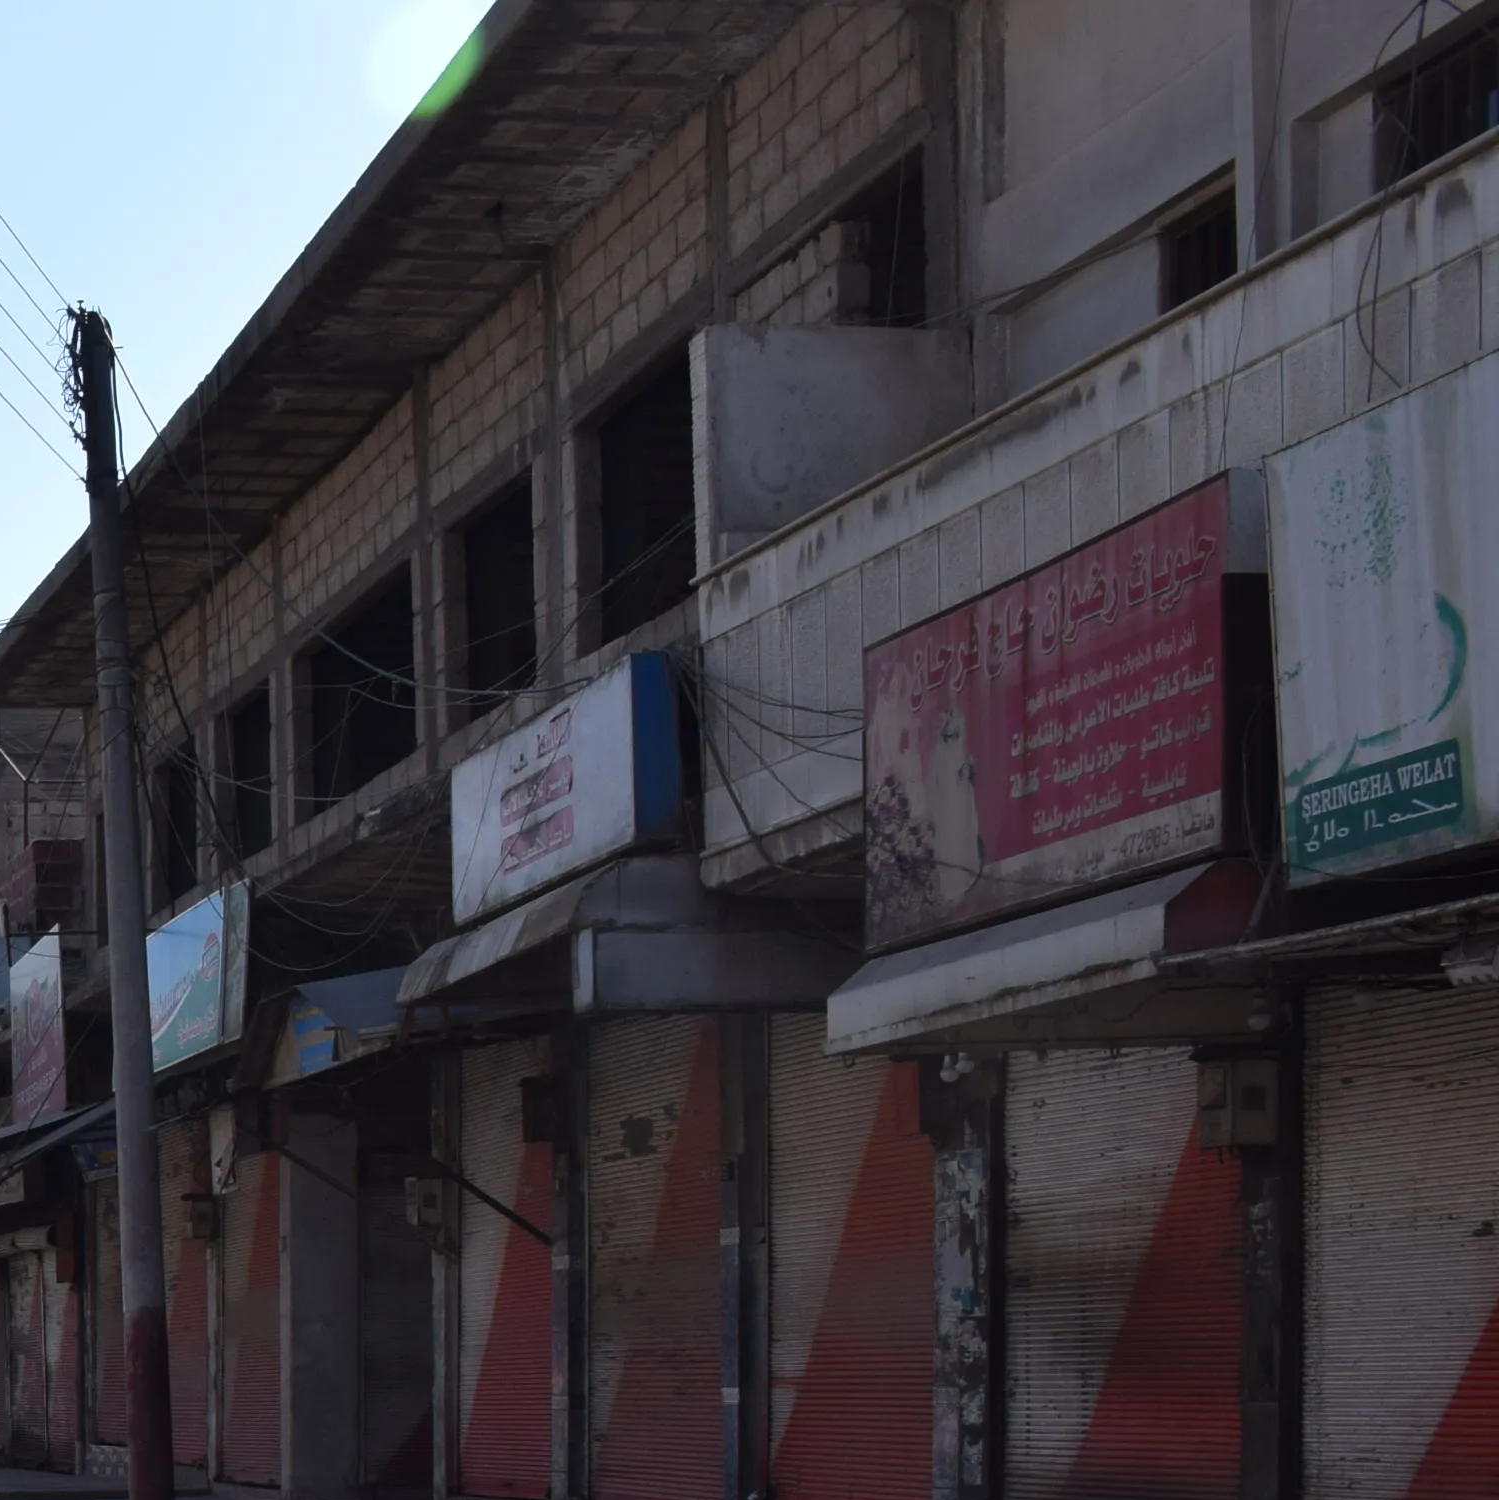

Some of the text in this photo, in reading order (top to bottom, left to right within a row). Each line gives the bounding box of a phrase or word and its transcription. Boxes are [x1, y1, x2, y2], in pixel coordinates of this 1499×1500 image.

[1126, 530, 1217, 611] حلويات
[1041, 562, 1120, 655] رضوان
[1152, 670, 1180, 703] كافة
[1181, 657, 1215, 695] تلبية
[1112, 684, 1150, 720] طلبات
[1174, 704, 1213, 747] قوالب
[1396, 753, 1456, 791] WELAT
